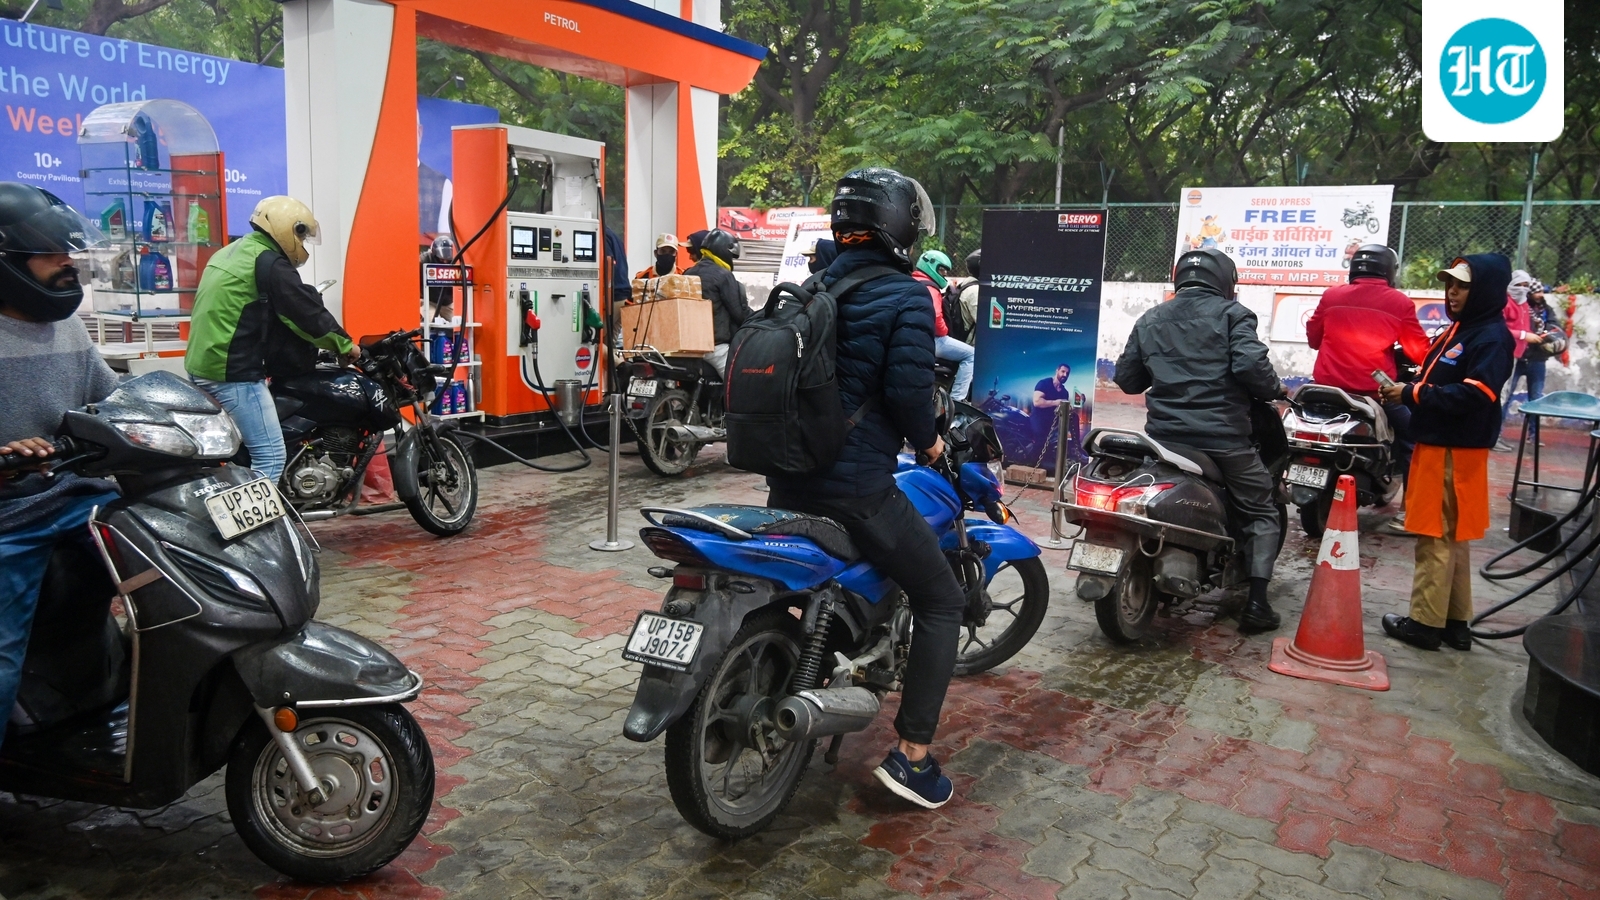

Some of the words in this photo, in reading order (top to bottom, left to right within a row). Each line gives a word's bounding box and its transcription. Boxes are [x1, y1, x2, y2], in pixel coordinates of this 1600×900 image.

[544, 12, 580, 33] PETROL
[100, 39, 128, 63] of
[138, 42, 230, 85] Energy
[0, 66, 50, 98] the
[58, 72, 146, 104] World
[34, 152, 62, 168] 10+
[17, 172, 47, 181] Country
[48, 173, 80, 182] Pavilions
[225, 168, 247, 182] 00+
[144, 180, 171, 188] Compani
[237, 187, 262, 195] Sessions
[1068, 215, 1098, 224] SERVO
[1244, 210, 1316, 223] FREE
[1231, 226, 1268, 243] बाईक
[1273, 225, 1333, 242] सर्विसिंग
[1239, 244, 1267, 258] इंजन
[1272, 244, 1310, 258] ऑयल
[1315, 245, 1337, 258] चेंज
[785, 255, 806, 267] बाईक
[1270, 272, 1284, 281] का
[1288, 273, 1318, 282] MRP
[1323, 272, 1340, 282] देय
[1026, 283, 1088, 292] DEFAULT
[1007, 305, 1060, 313] HYPERSPORT
[193, 481, 231, 498] HONDA
[648, 618, 694, 642] UP15B
[641, 637, 689, 660] J9074
